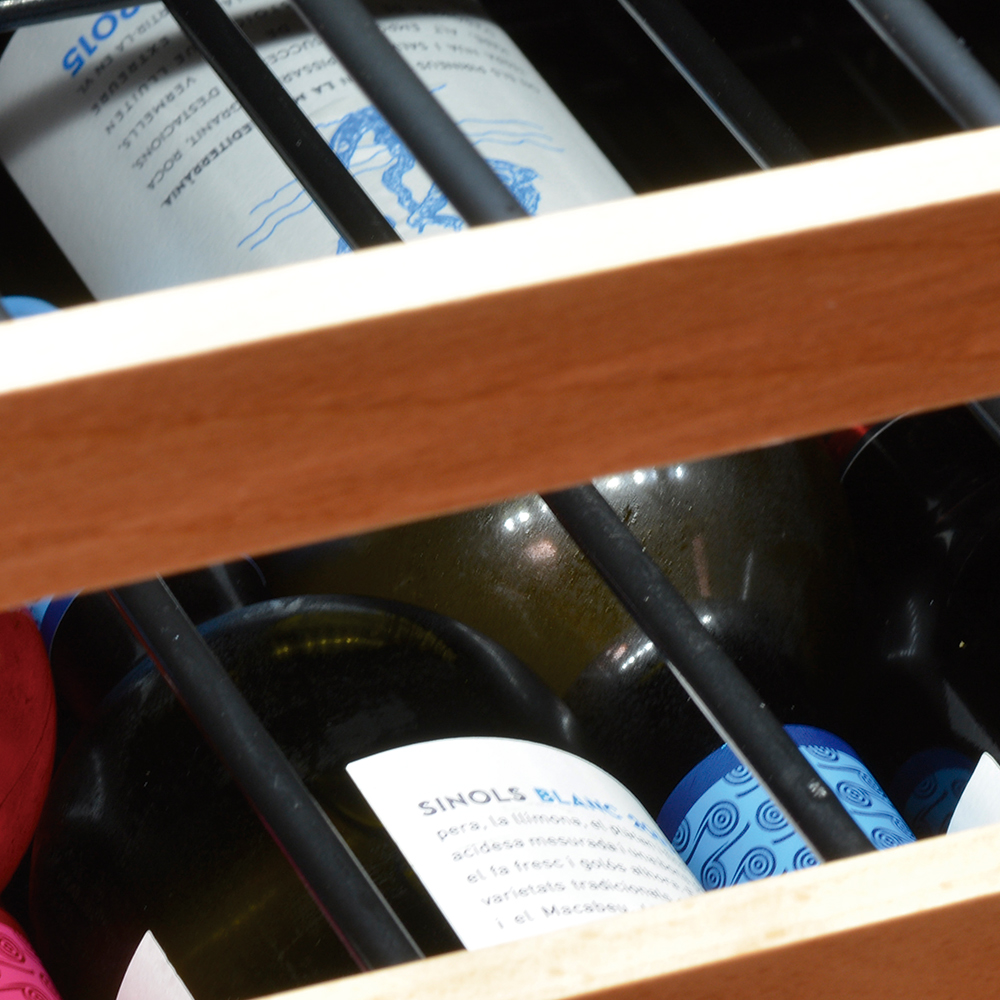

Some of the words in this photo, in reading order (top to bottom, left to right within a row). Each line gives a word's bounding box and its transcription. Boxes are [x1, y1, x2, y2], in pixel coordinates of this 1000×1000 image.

[147, 149, 183, 190] ROCA
[418, 786, 527, 816] SINOLS
[533, 786, 623, 820] BLANC
[451, 836, 525, 862] acidesa
[466, 868, 487, 884] el
[489, 864, 510, 878] fa
[513, 857, 566, 873] fresc
[481, 880, 566, 906] varietats
